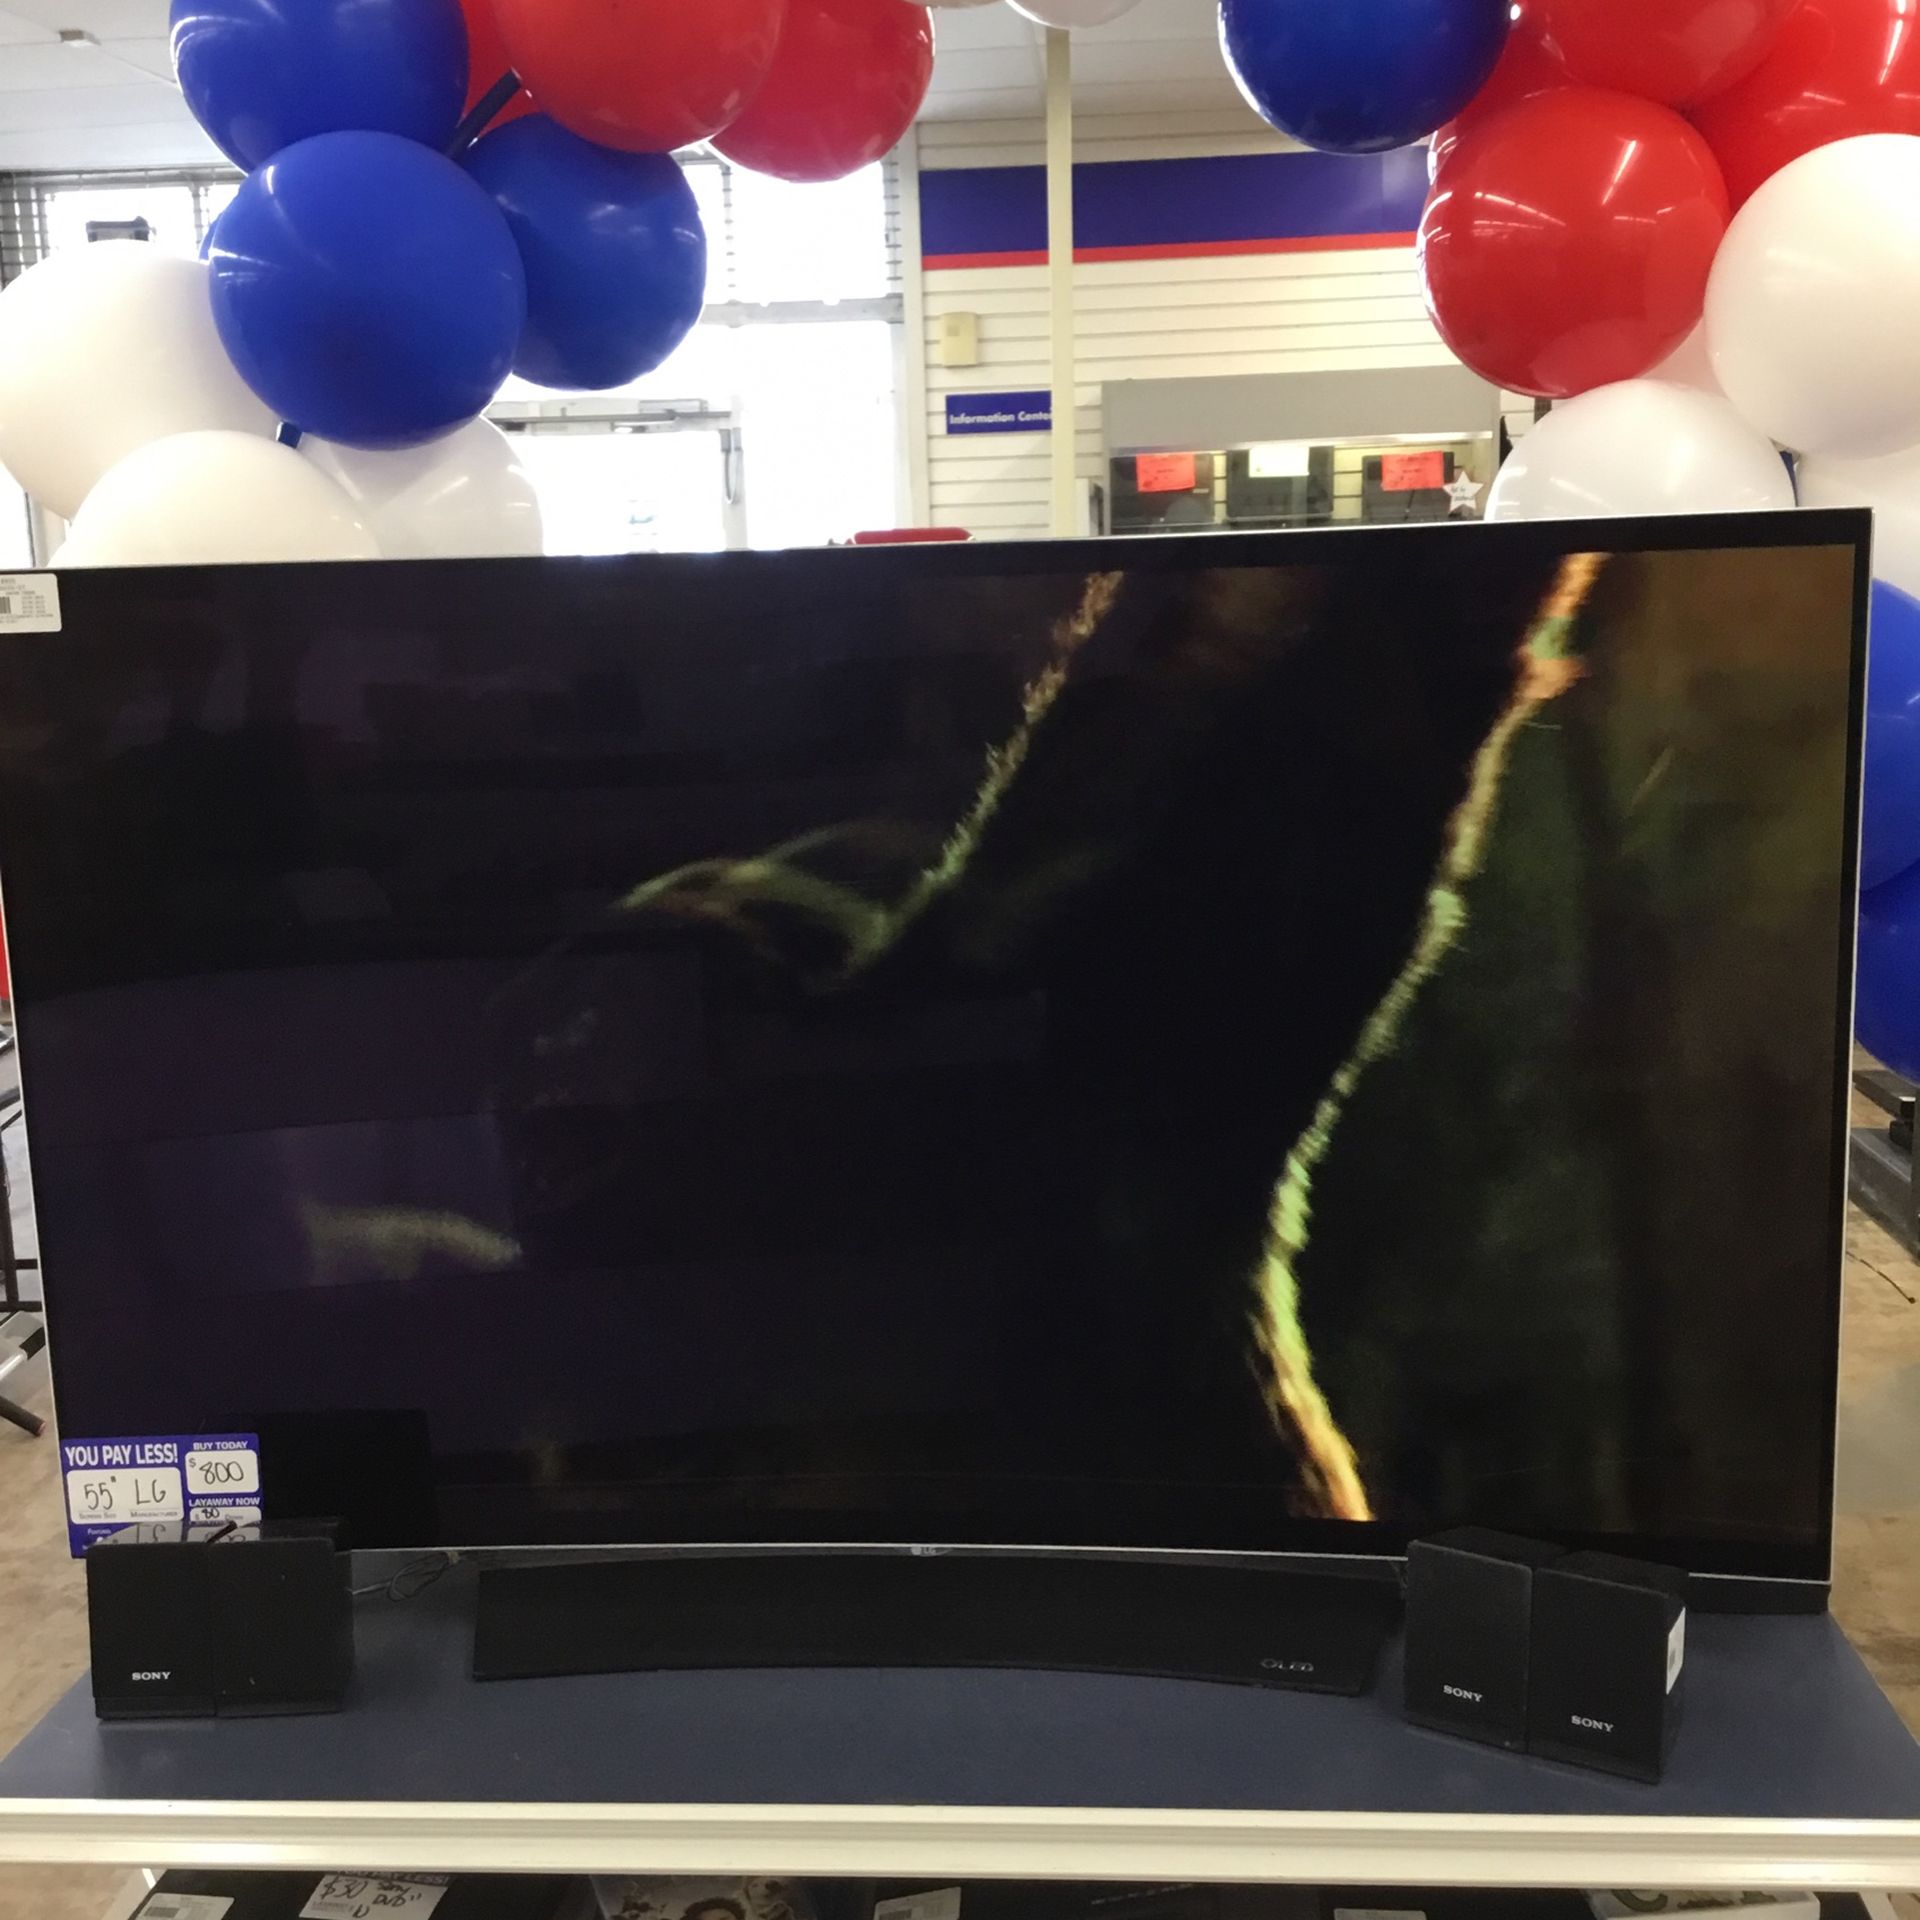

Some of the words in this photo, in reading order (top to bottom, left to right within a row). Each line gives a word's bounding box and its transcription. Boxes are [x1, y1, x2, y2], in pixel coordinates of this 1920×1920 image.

[950, 412, 1014, 424] Information
[65, 1446, 98, 1466] YOU
[102, 1445, 131, 1465] PAY
[136, 1443, 178, 1464] LESS!
[193, 1442, 213, 1450] BUY
[215, 1441, 248, 1449] TODAY
[189, 1458, 196, 1468] $
[199, 1461, 244, 1485] 800
[84, 1476, 116, 1510] 55"
[135, 1479, 166, 1505] LG
[189, 1498, 234, 1507] LAYAWAY
[235, 1497, 260, 1505] NOW
[132, 1671, 171, 1681] SONY
[1443, 1684, 1483, 1702] SONY
[1571, 1715, 1614, 1733] SONY
